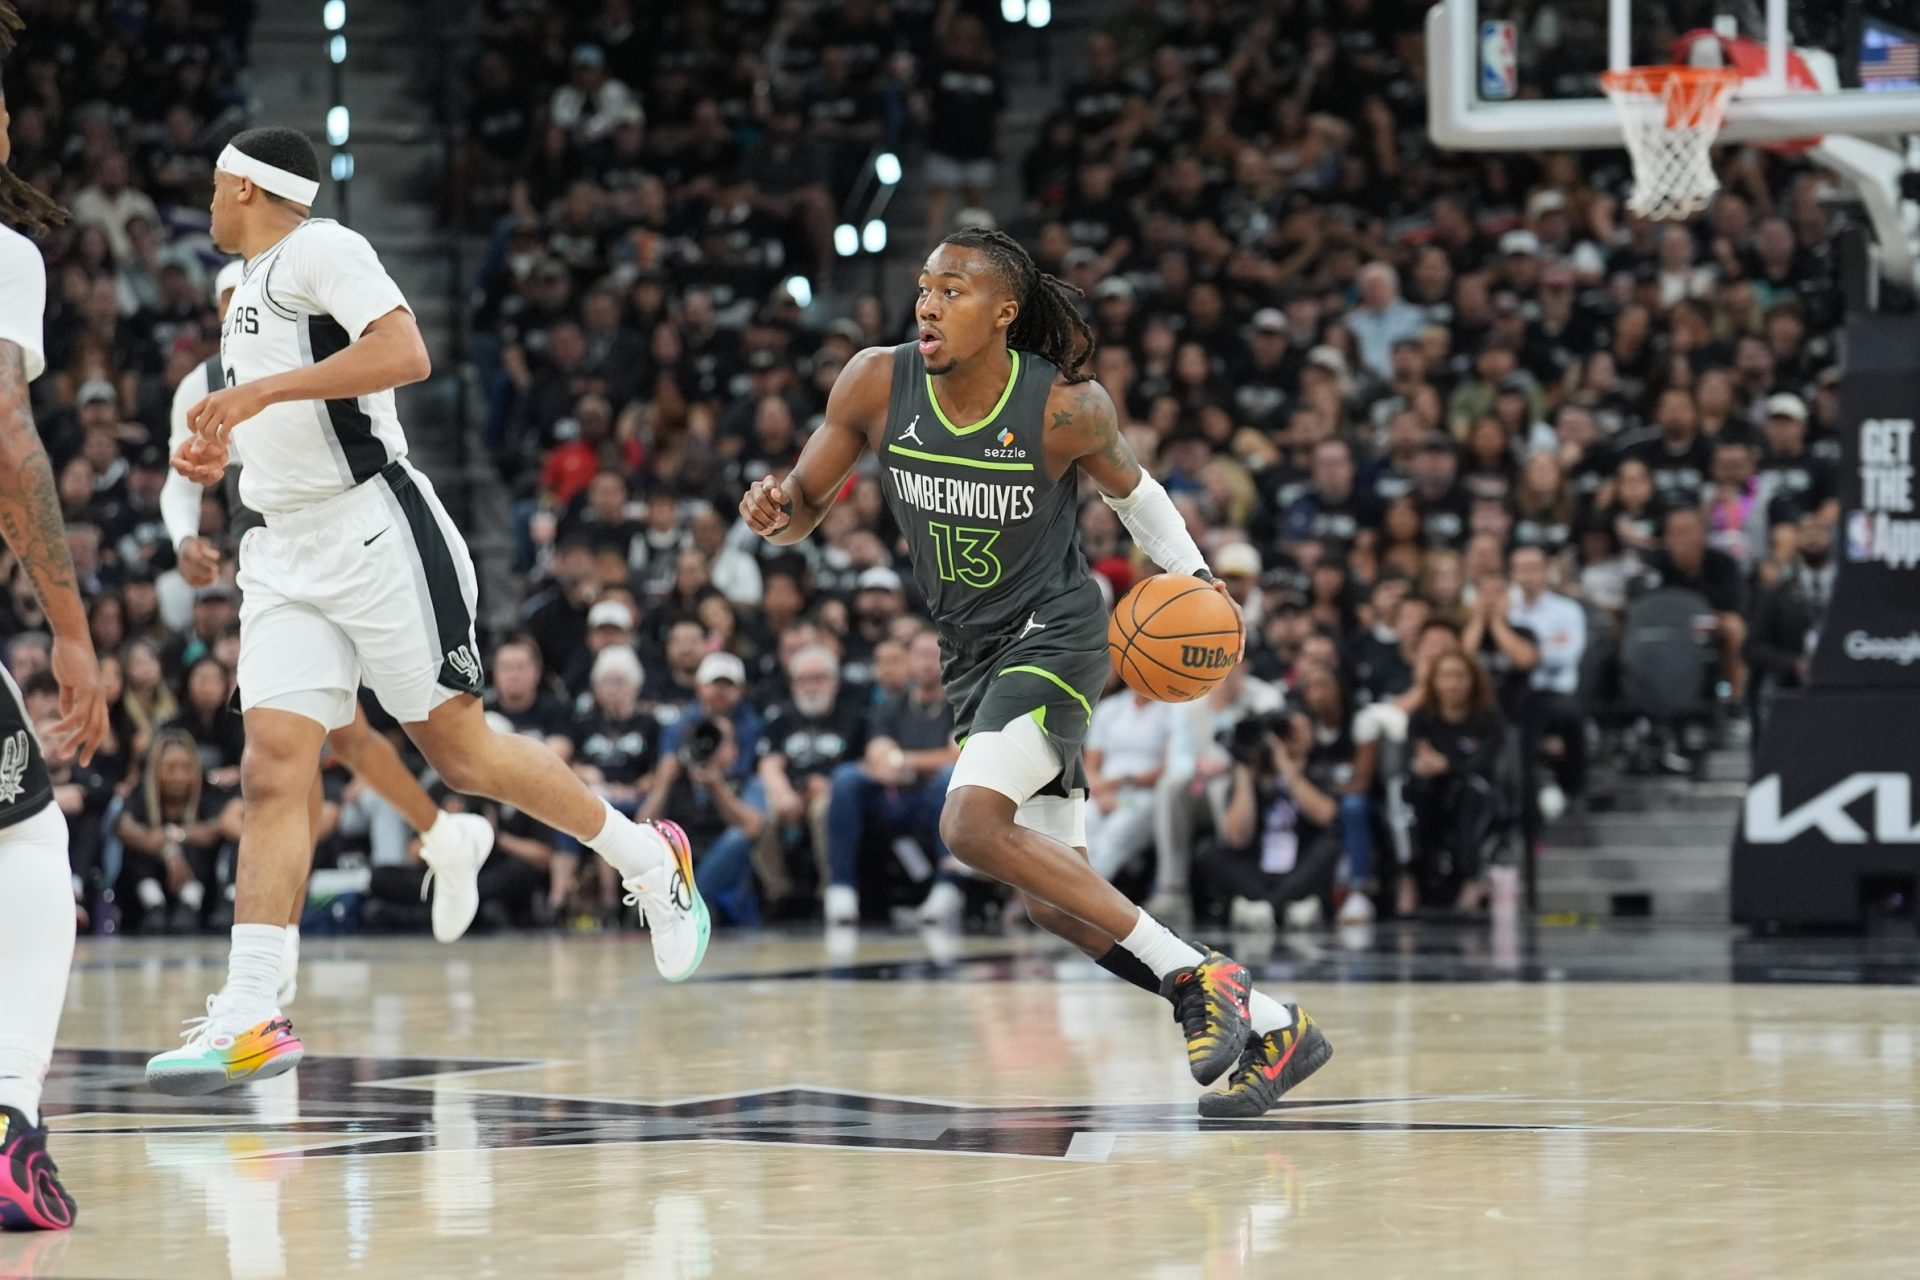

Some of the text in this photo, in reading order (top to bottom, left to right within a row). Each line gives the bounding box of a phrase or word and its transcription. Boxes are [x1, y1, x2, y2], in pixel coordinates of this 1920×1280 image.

[984, 447, 1026, 458] sezzle
[1860, 419, 1914, 464] GET
[889, 467, 1035, 526] TIMBERWOLVES
[1861, 466, 1914, 512] THE
[929, 520, 1001, 588] 13
[1845, 630, 1920, 666] Googl
[1746, 771, 1920, 844] KI
